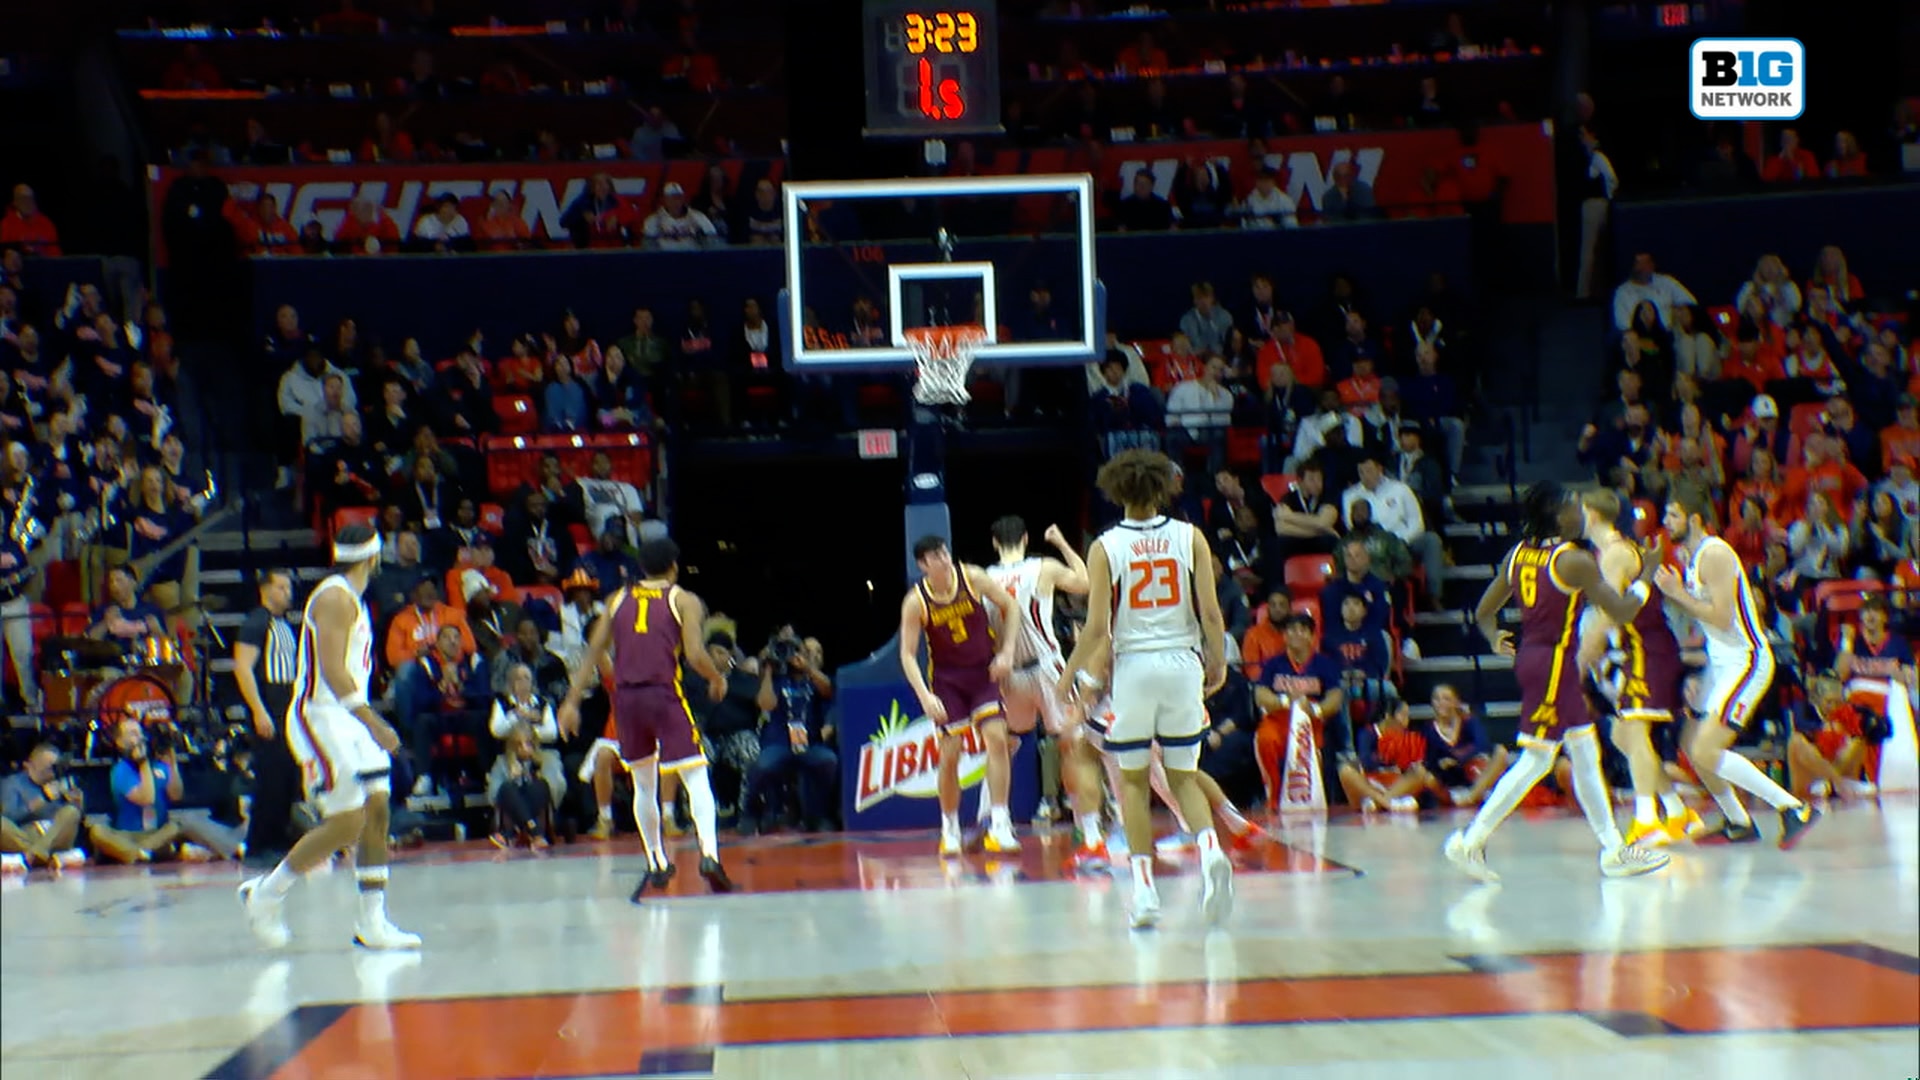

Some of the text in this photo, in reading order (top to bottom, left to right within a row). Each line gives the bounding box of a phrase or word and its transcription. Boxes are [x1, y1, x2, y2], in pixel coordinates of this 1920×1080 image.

[904, 12, 978, 54] 3:23
[1130, 559, 1180, 609] 23
[1519, 565, 1537, 608] 6
[634, 598, 649, 633] 1
